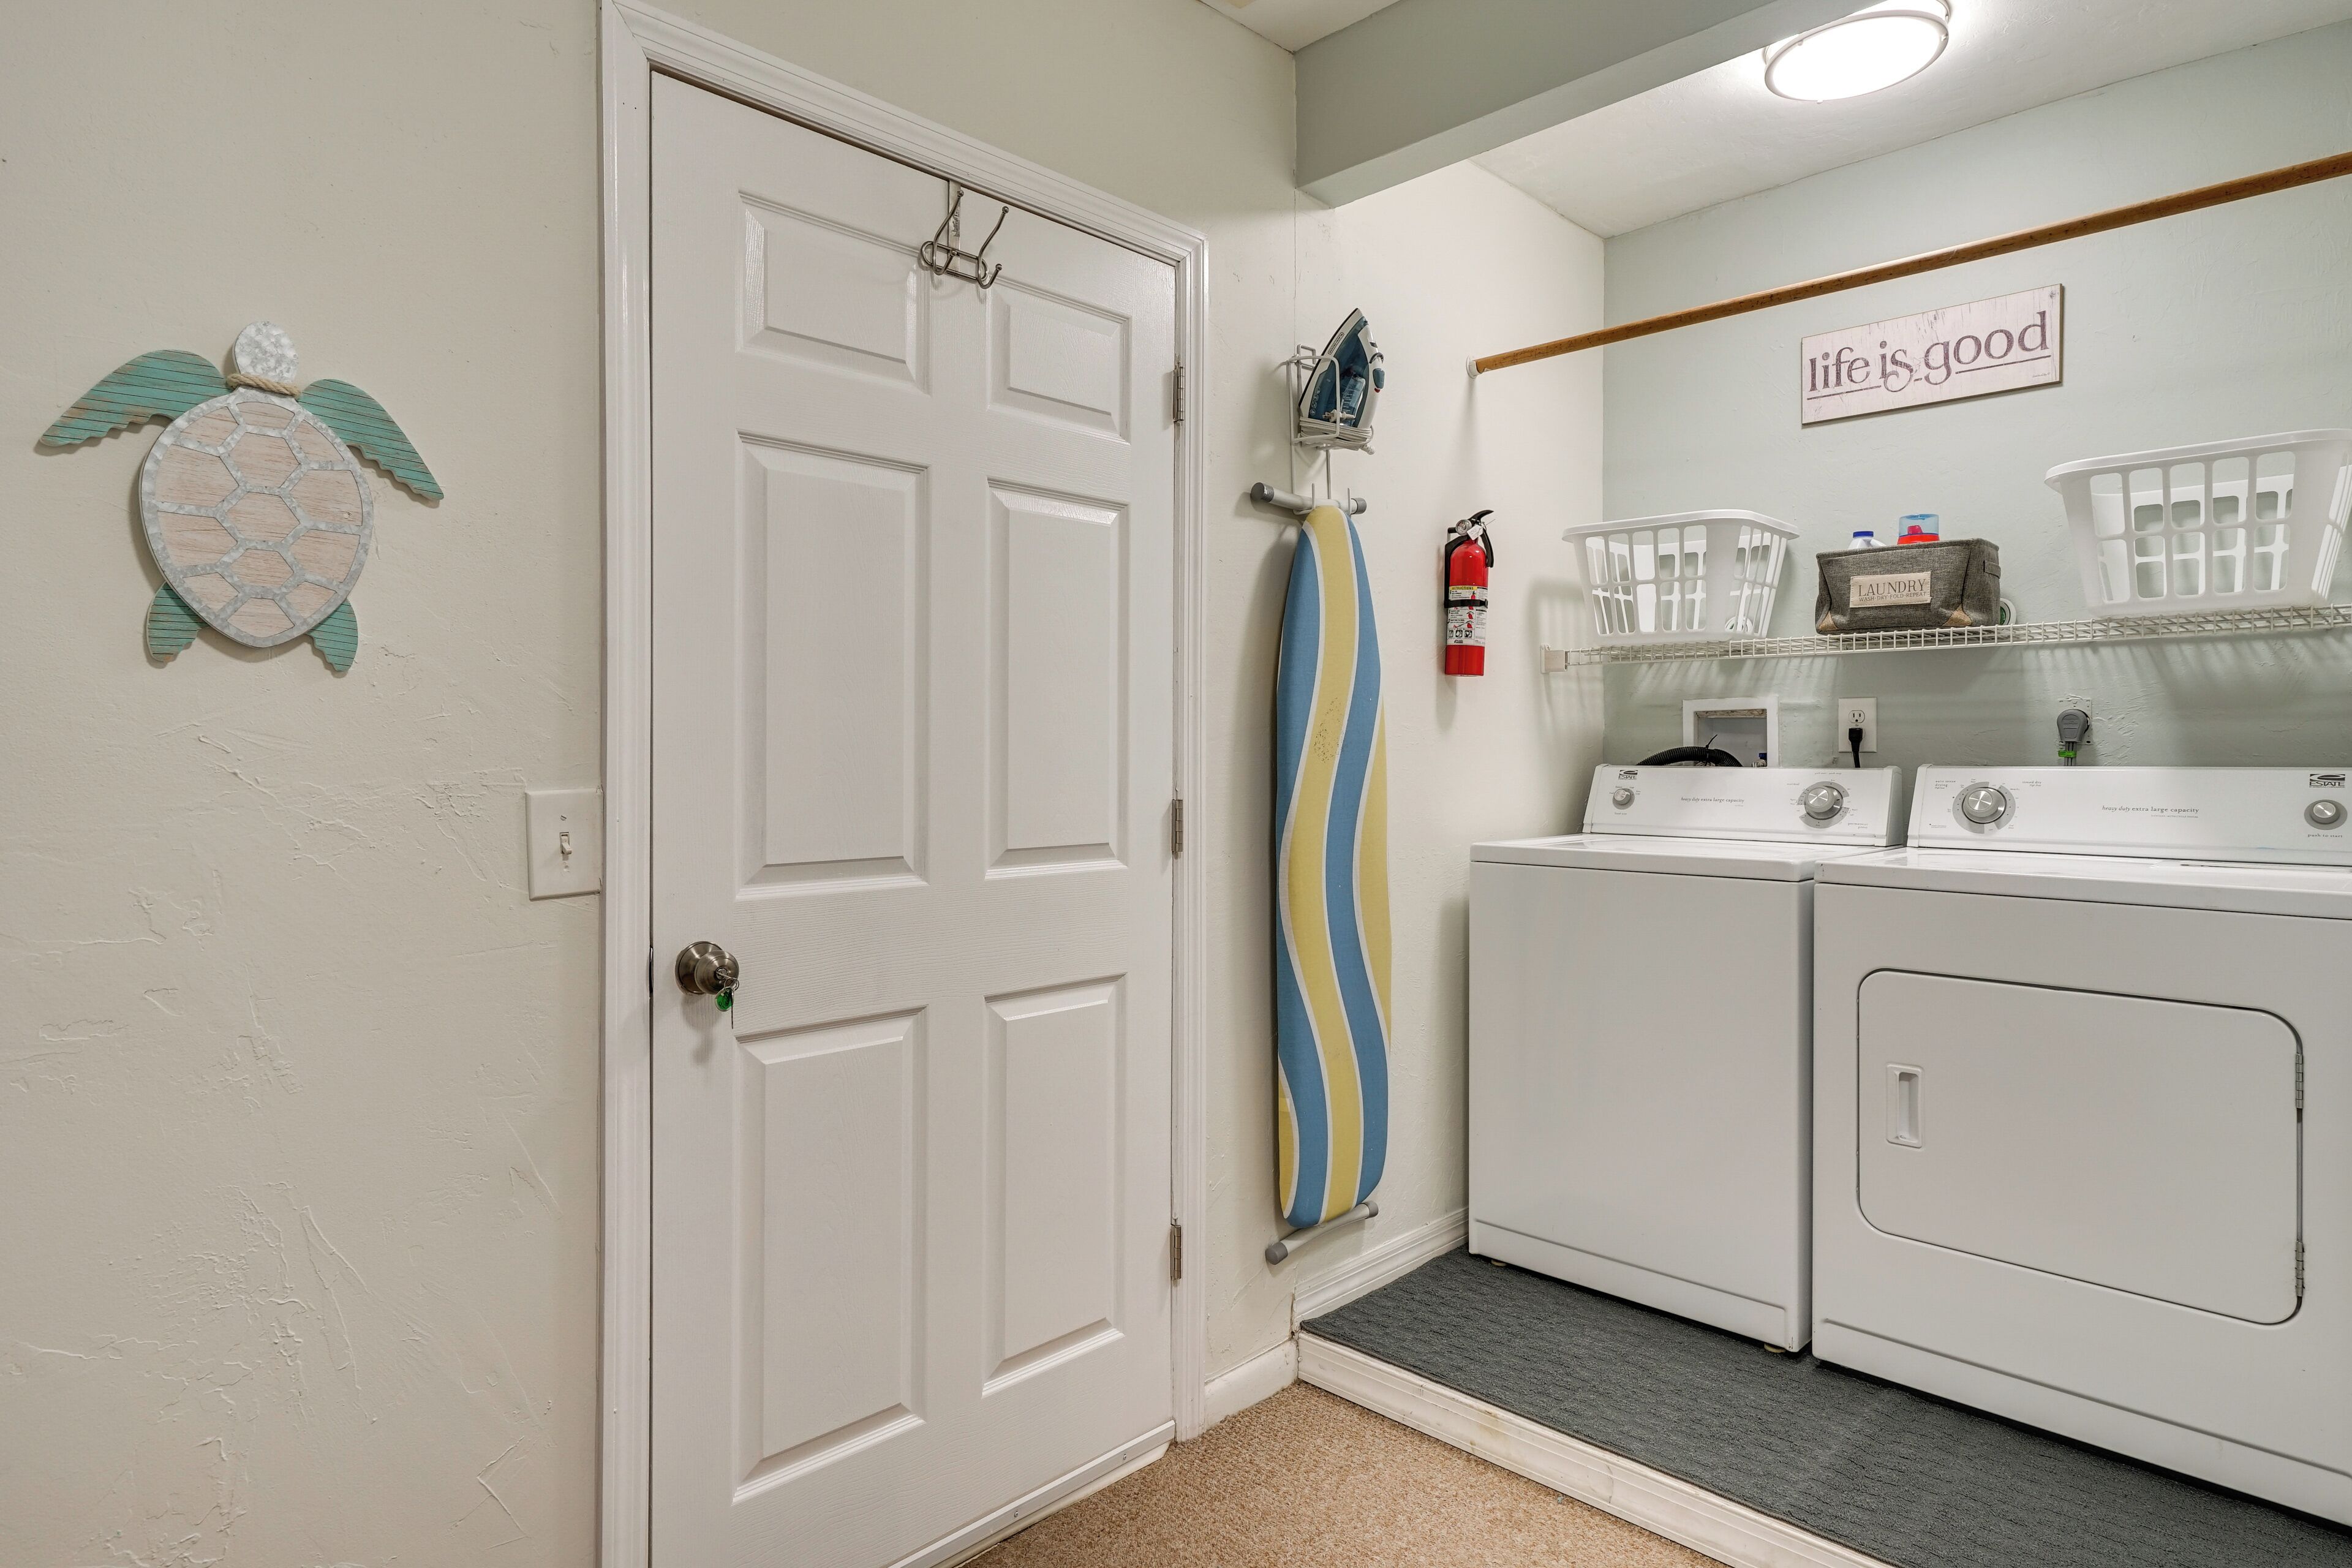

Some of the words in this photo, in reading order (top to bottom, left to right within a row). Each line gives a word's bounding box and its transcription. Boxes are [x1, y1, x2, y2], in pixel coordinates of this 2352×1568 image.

[1808, 347, 1870, 392] life
[1879, 340, 1916, 393] is
[1924, 311, 2049, 385] good
[1858, 579, 1926, 597] LAUNDRY
